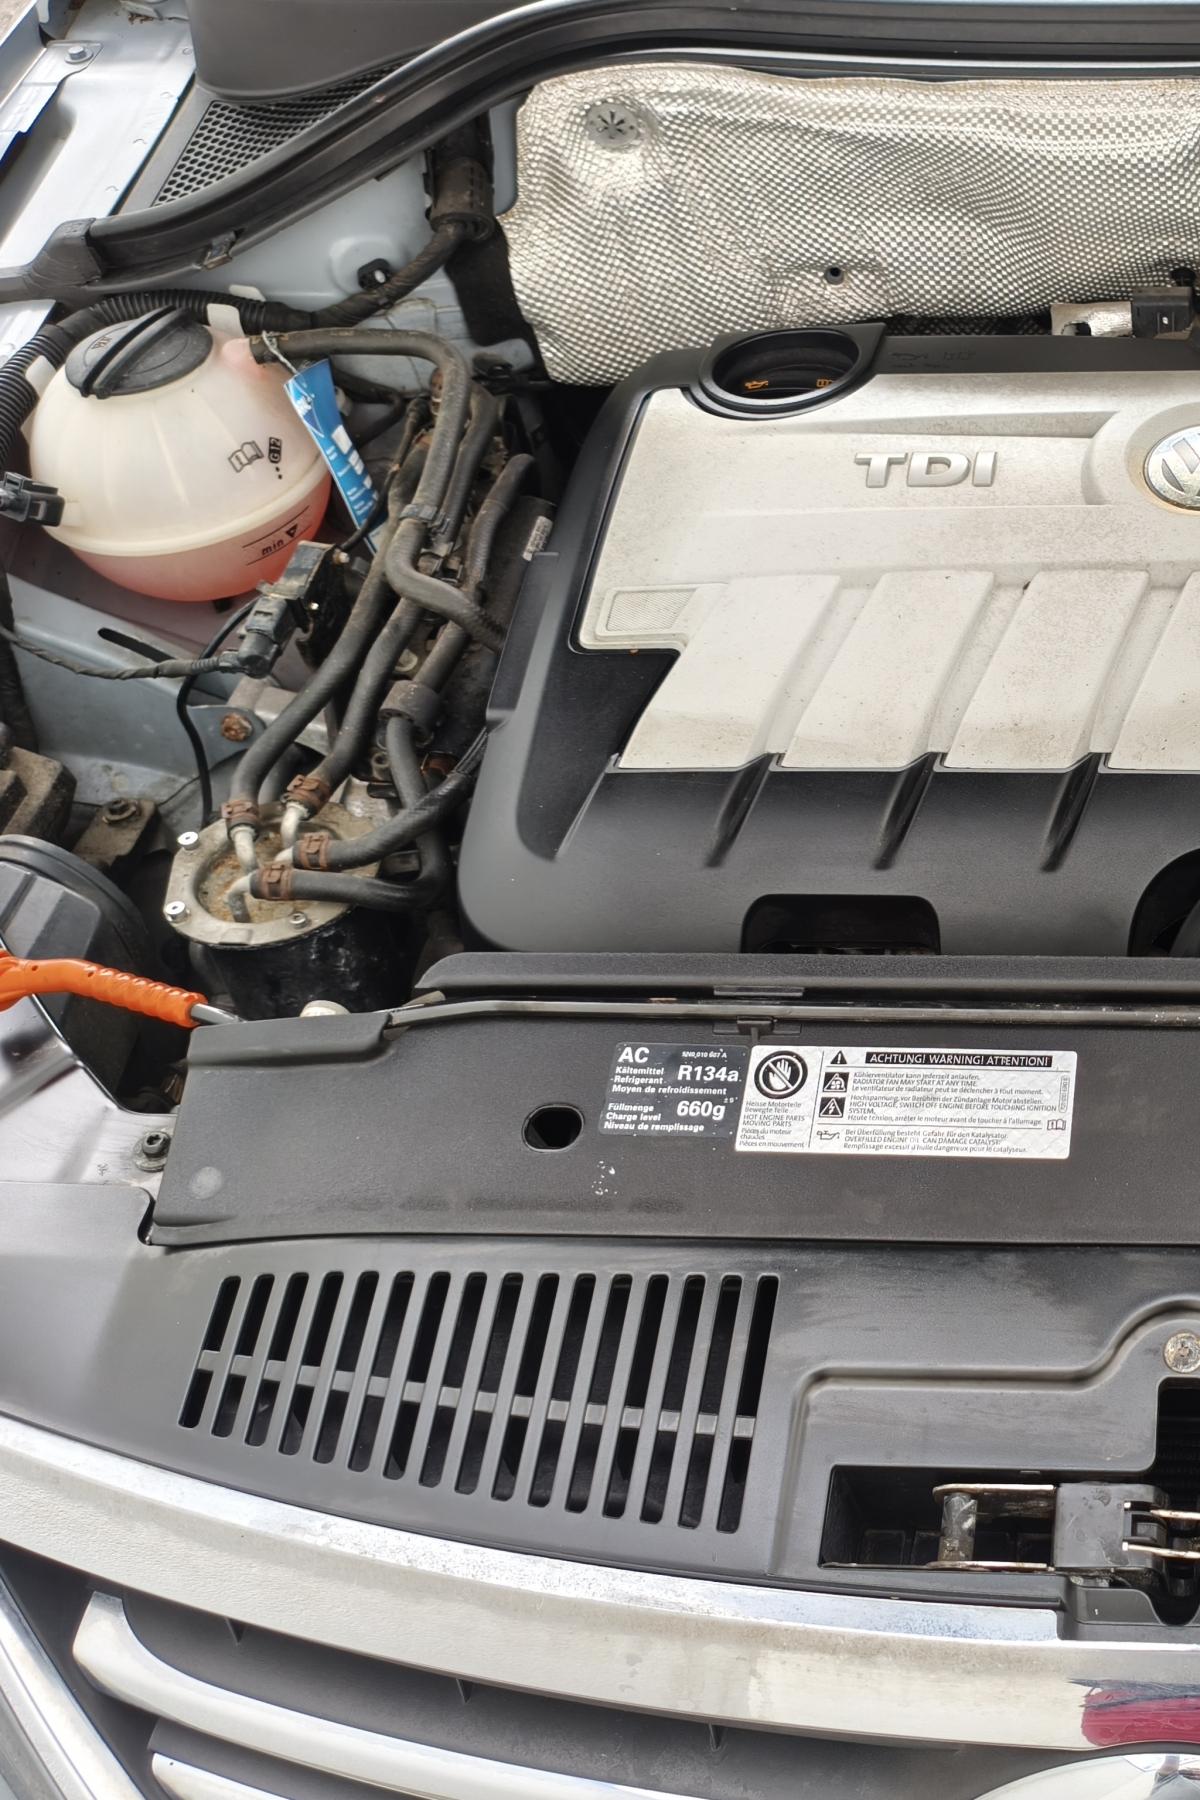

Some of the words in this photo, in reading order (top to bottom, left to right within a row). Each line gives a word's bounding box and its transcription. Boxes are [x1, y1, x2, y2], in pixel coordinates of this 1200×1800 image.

[855, 451, 997, 488] TDI
[261, 540, 284, 556] min
[618, 1046, 650, 1063] AC
[870, 1053, 925, 1064] ACHTUNG!
[929, 1055, 984, 1065] WARNING!
[986, 1056, 1048, 1066] ATTENTION!
[615, 1066, 664, 1075] Kältemittel
[677, 1064, 739, 1082] R134a
[613, 1075, 663, 1085] Refrigerant
[612, 1085, 642, 1094] Moyen
[658, 1086, 727, 1095] refroidissement
[607, 1103, 654, 1113] Füllmenge
[676, 1100, 726, 1121] 660g
[606, 1112, 638, 1121] Charge
[640, 1113, 662, 1121] level
[604, 1121, 635, 1130] Niveau
[638, 1122, 648, 1130] de
[651, 1122, 705, 1132] remplissage
